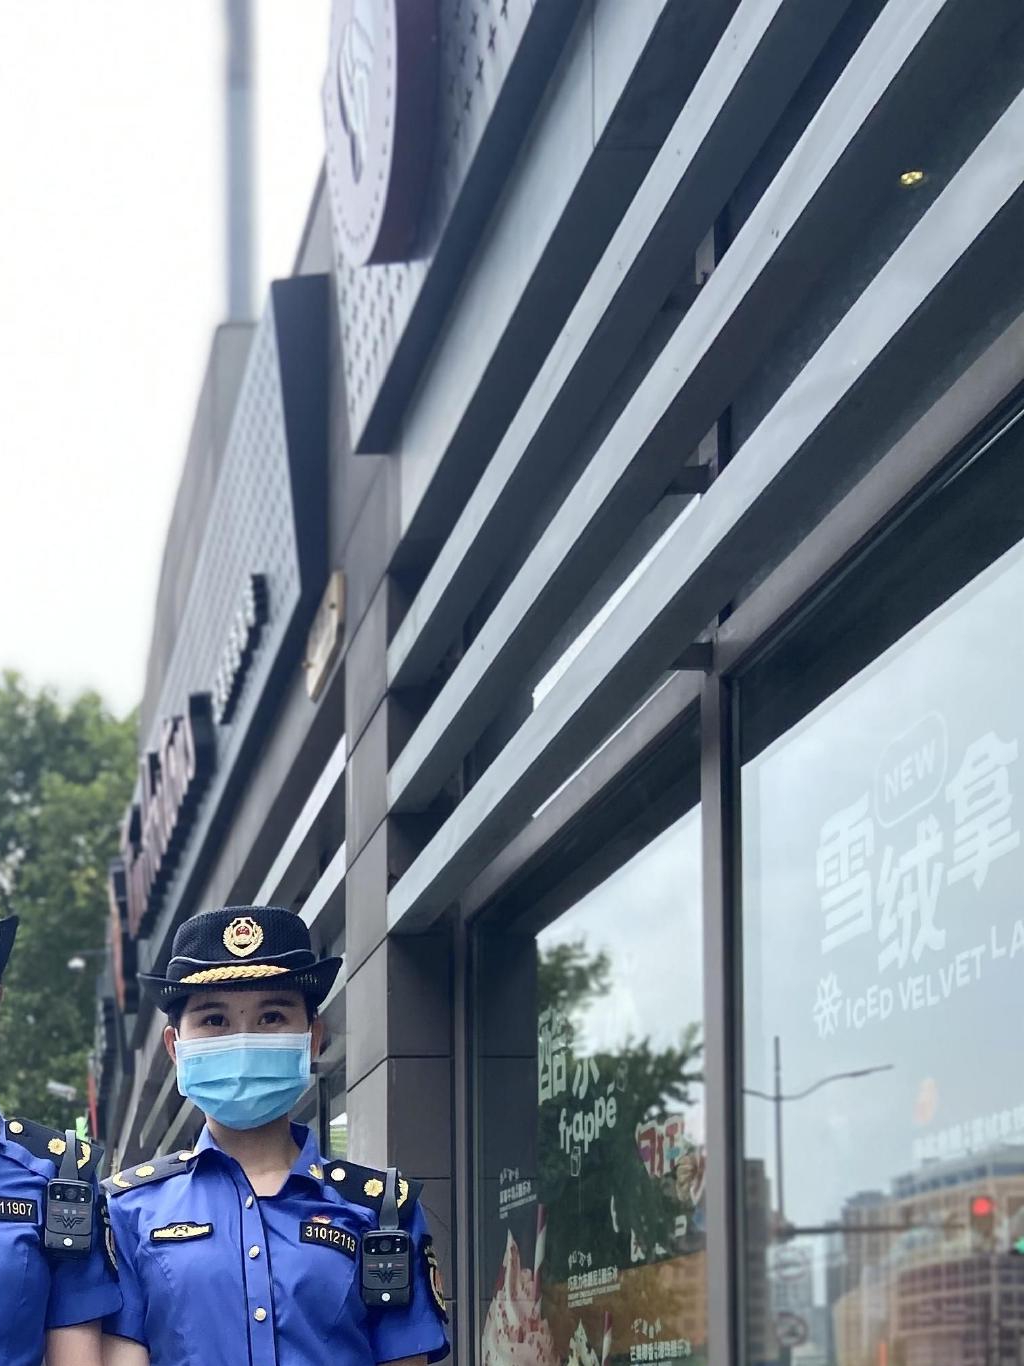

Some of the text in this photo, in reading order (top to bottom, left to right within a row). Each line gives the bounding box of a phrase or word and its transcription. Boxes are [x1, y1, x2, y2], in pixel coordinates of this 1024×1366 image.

[883, 739, 937, 803] NEW
[816, 731, 1020, 972] 雪绒拿
[845, 984, 893, 1028] ICED
[898, 944, 986, 1012] VELVET
[558, 1080, 618, 1155] frappé
[305, 1226, 356, 1252] 31012113
